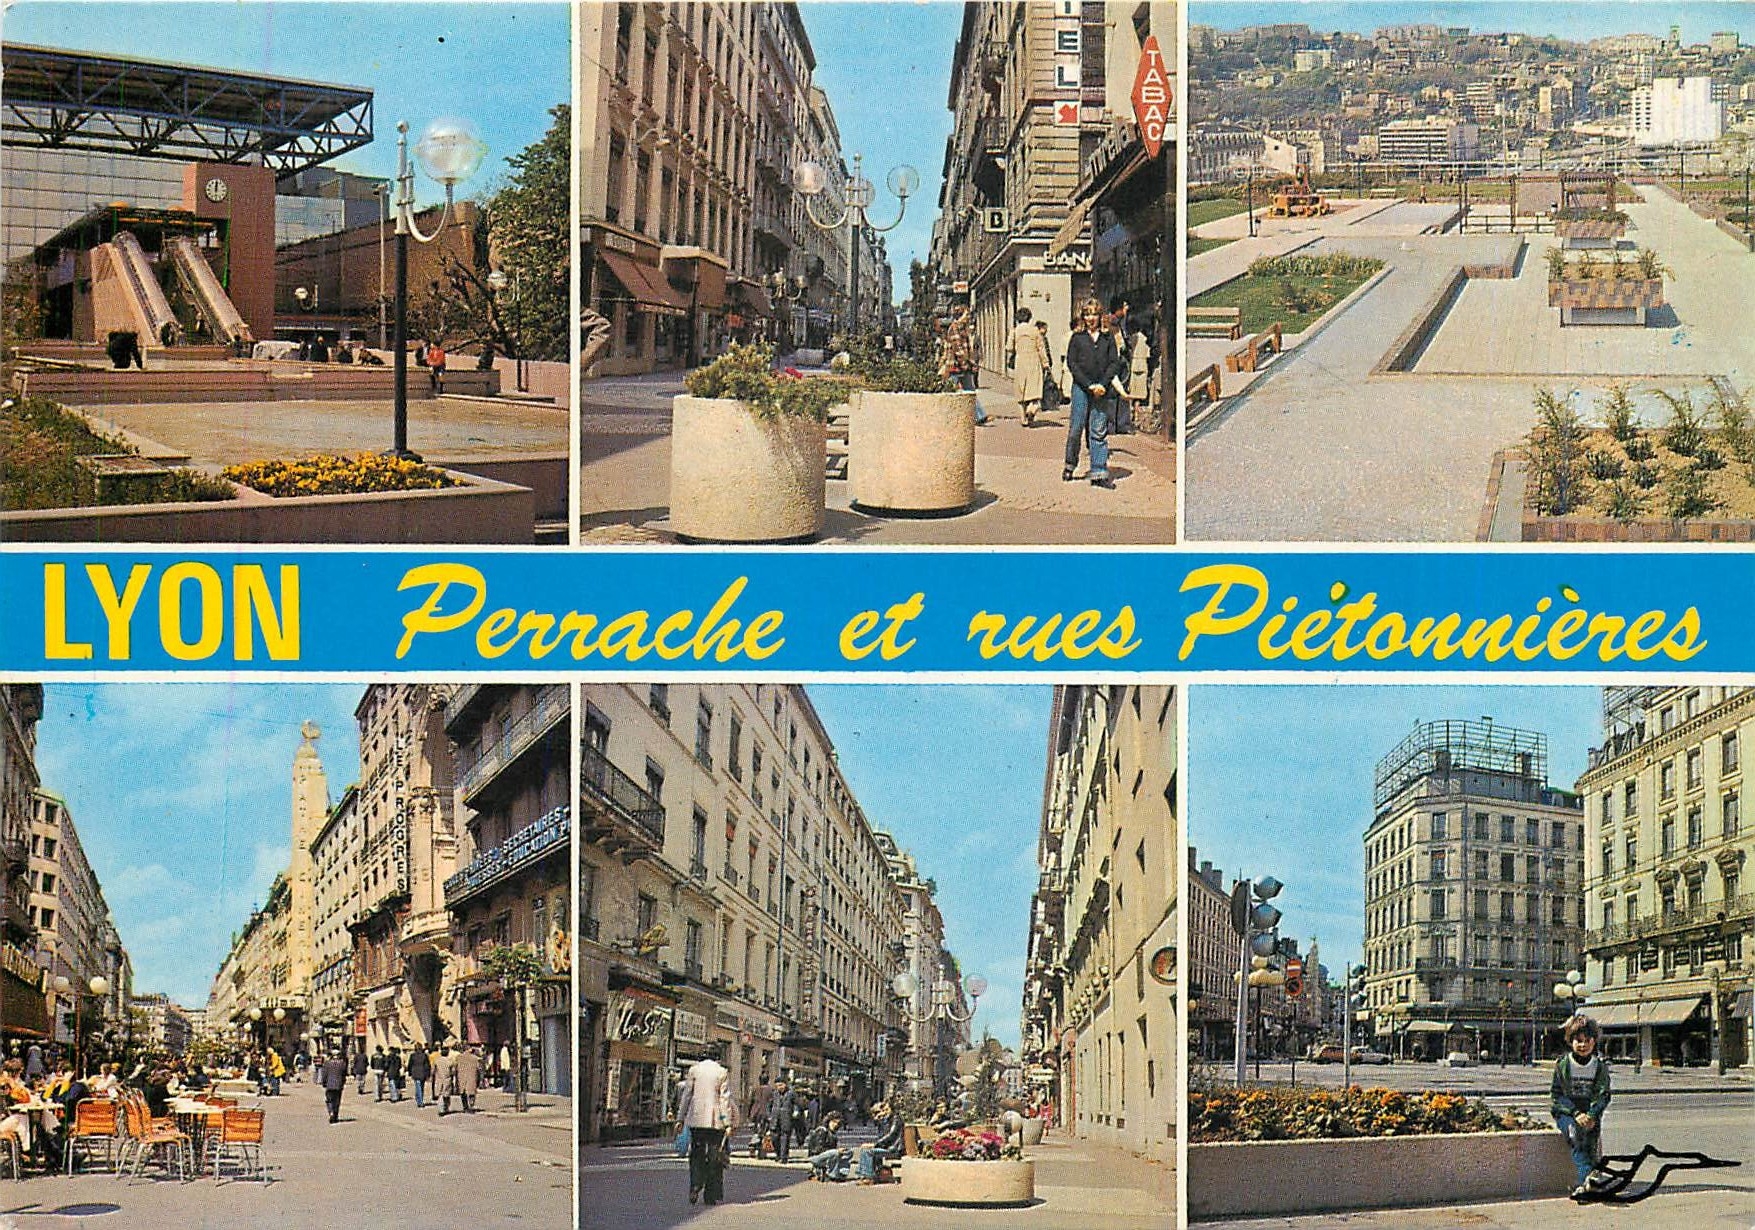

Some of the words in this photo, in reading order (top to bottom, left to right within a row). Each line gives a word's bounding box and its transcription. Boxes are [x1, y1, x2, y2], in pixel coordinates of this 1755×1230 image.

[1141, 49, 1166, 141] TABAC
[990, 211, 1004, 229] B
[395, 739, 404, 767] LE
[395, 780, 405, 891] PROGRES
[502, 806, 561, 854] SECRETAIRES
